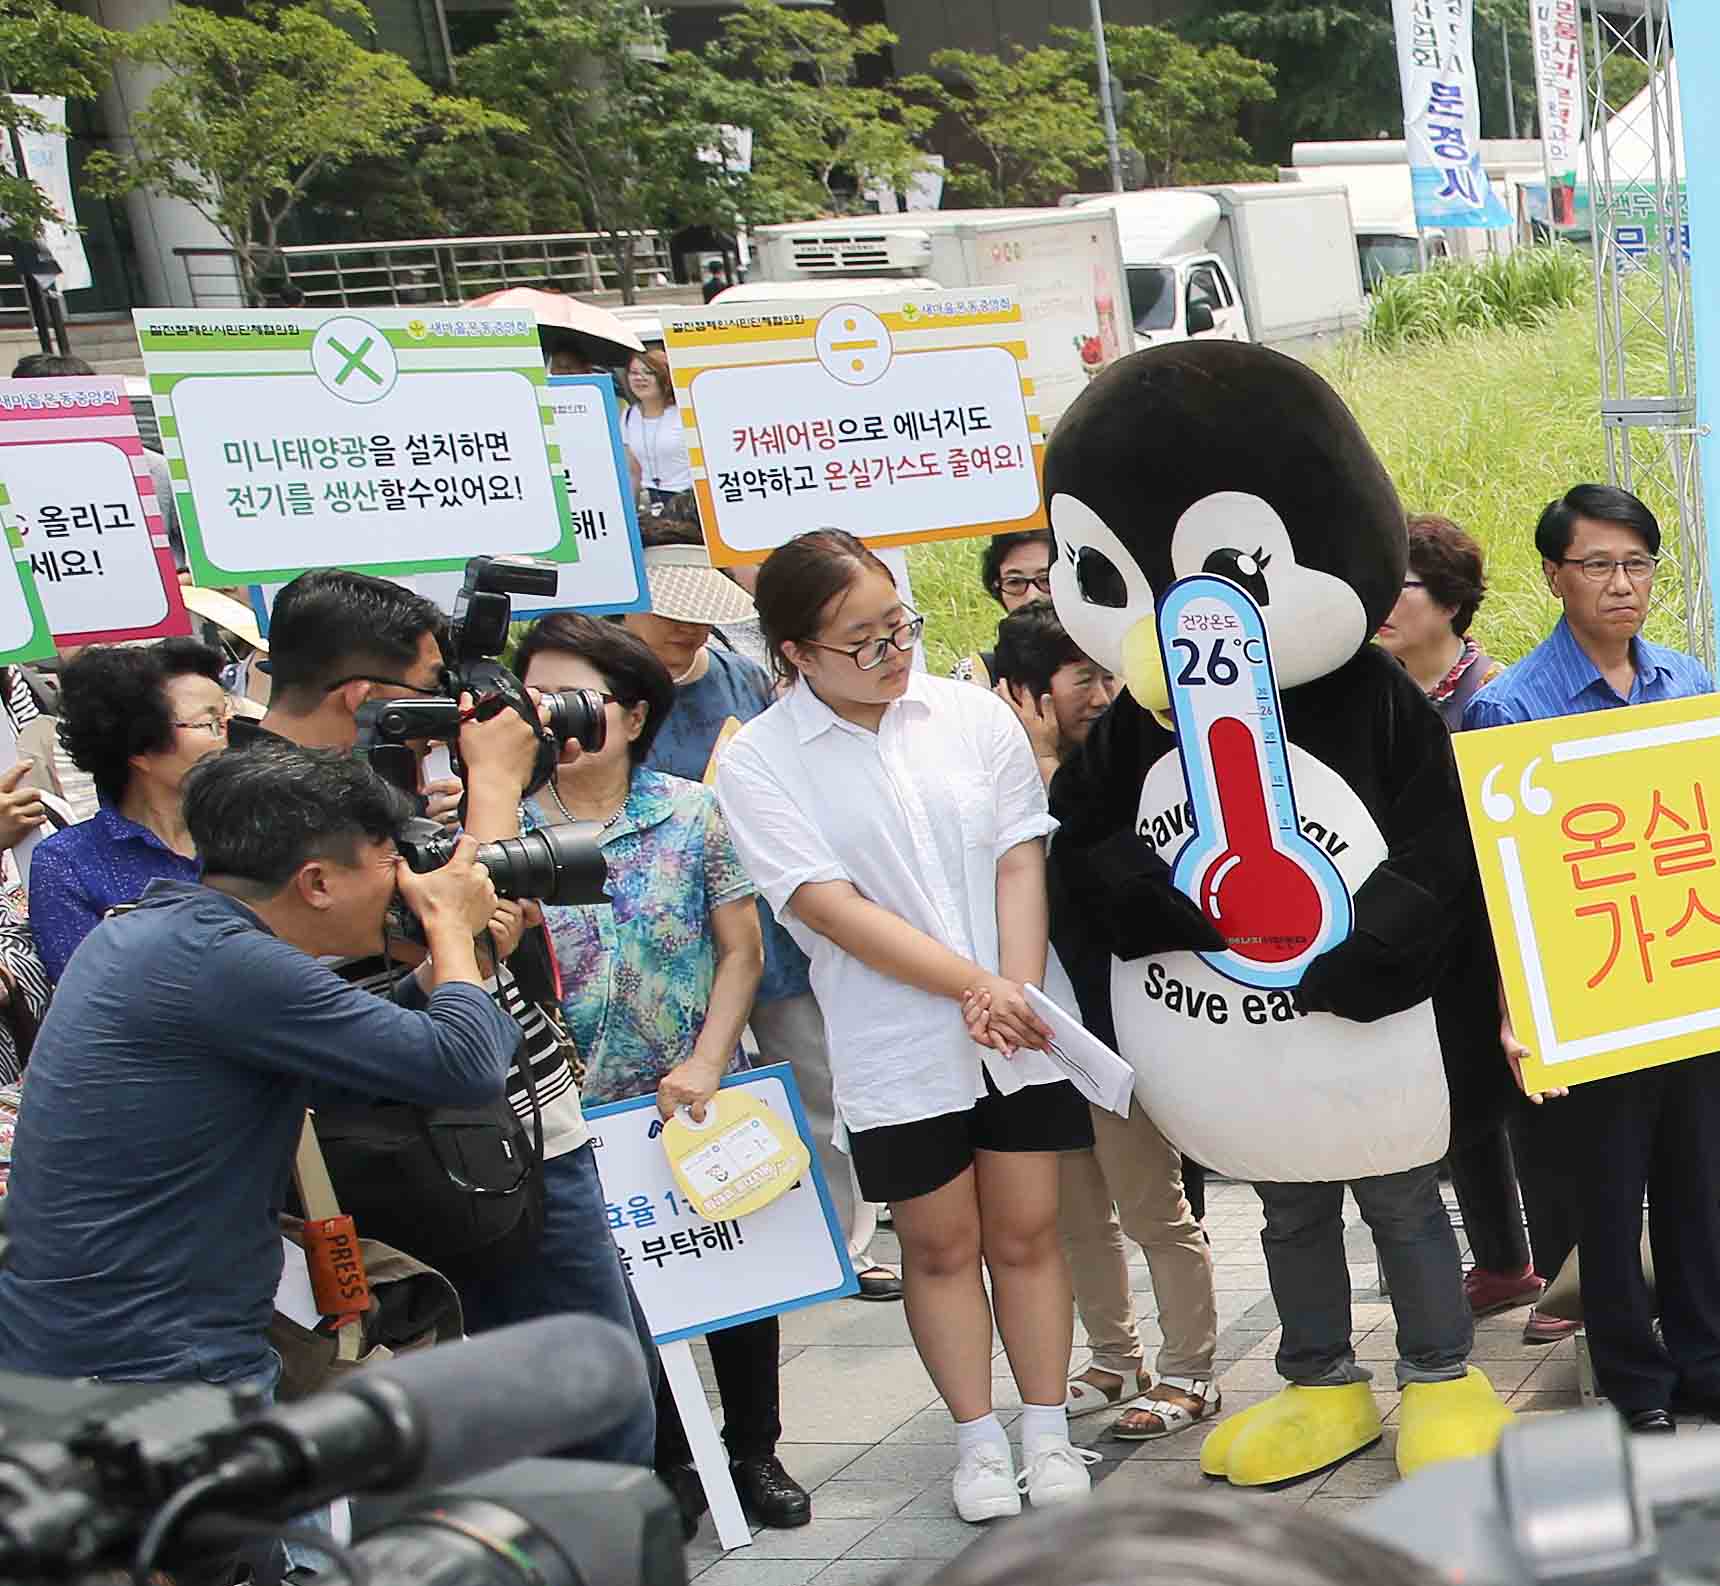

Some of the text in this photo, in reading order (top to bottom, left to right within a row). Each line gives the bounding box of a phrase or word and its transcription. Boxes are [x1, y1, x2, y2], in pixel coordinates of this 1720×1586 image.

[222, 430, 512, 476] 미니태양광을 설치하면
[732, 405, 993, 459] 카쉐어링으로 에너지도
[226, 483, 316, 520] 전기를
[322, 474, 524, 514] 생산할수있어요!
[717, 444, 1025, 504] 절약하고 온실가스도 줄여요!
[37, 503, 136, 540] 올리고
[1180, 614, 1239, 632] 건강온도
[1560, 782, 1718, 890] 온실
[1144, 962, 1308, 1025] Save ea
[325, 1232, 365, 1299] PRESS
[641, 1218, 744, 1269] 부탁해!
